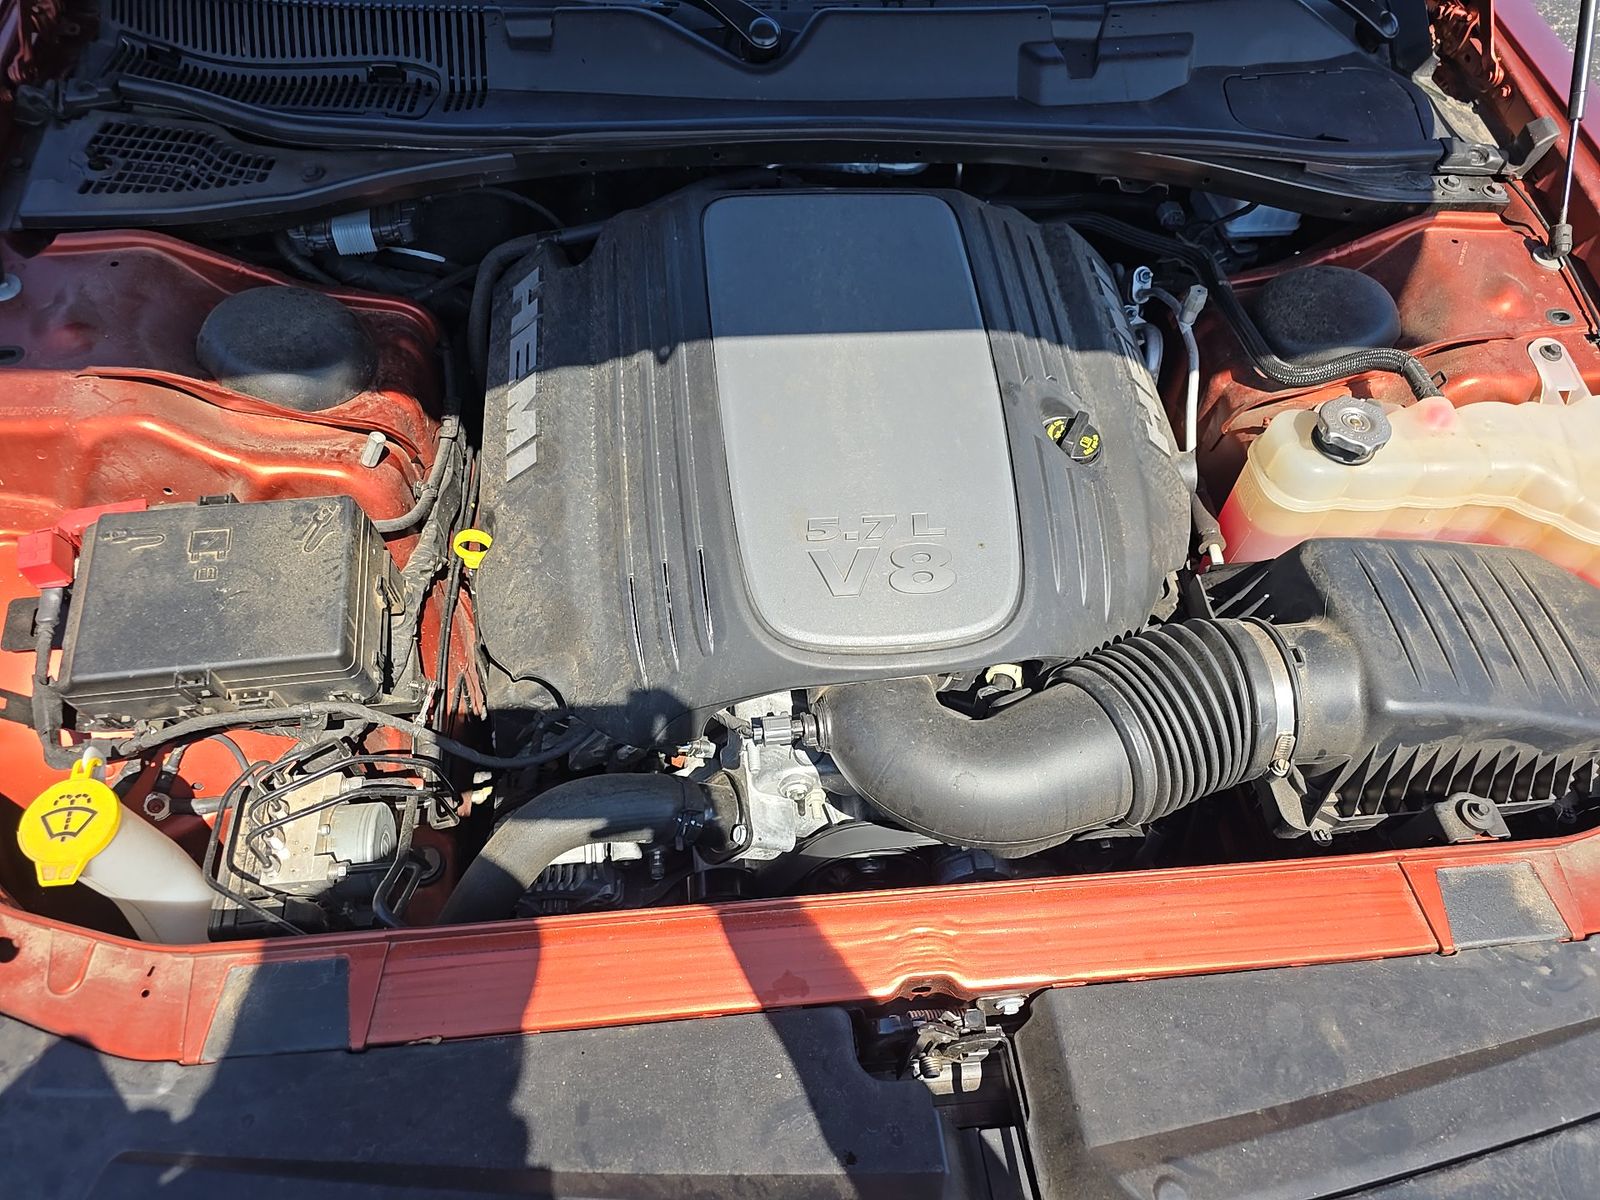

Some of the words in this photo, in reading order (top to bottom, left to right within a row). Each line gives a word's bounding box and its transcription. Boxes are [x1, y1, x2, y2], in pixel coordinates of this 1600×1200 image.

[507, 267, 539, 482] HEMI
[1092, 258, 1171, 456] HEMI
[806, 542, 958, 598] V8
